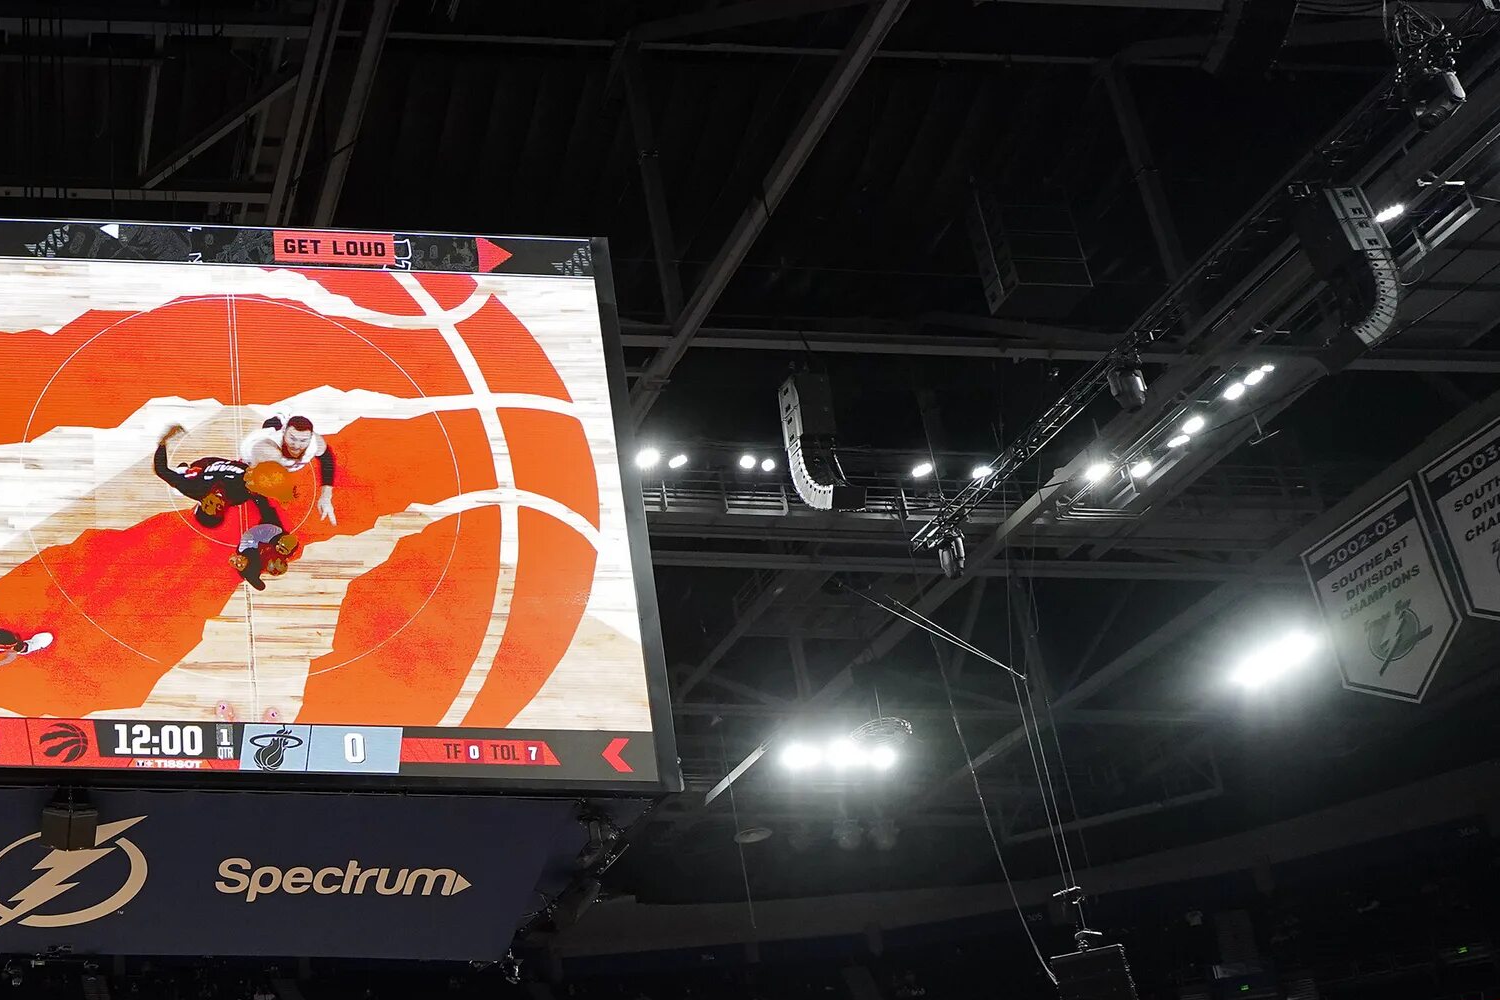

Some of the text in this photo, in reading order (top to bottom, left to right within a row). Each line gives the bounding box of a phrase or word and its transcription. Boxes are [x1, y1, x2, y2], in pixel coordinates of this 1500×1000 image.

[282, 237, 387, 258] GET LOUD
[1326, 512, 1398, 570] 2002-03
[1331, 536, 1409, 593] SOUTHEAST
[1346, 558, 1404, 601] DIVISION
[1340, 564, 1421, 621] CHAMPIONS
[113, 723, 203, 757] 12:00
[217, 746, 234, 760] QTR
[220, 728, 231, 746] 1
[344, 732, 366, 764] 0
[443, 743, 538, 761] TF 0 TOL 7
[156, 759, 203, 769] TISSOT
[215, 857, 458, 903] Spectrum
